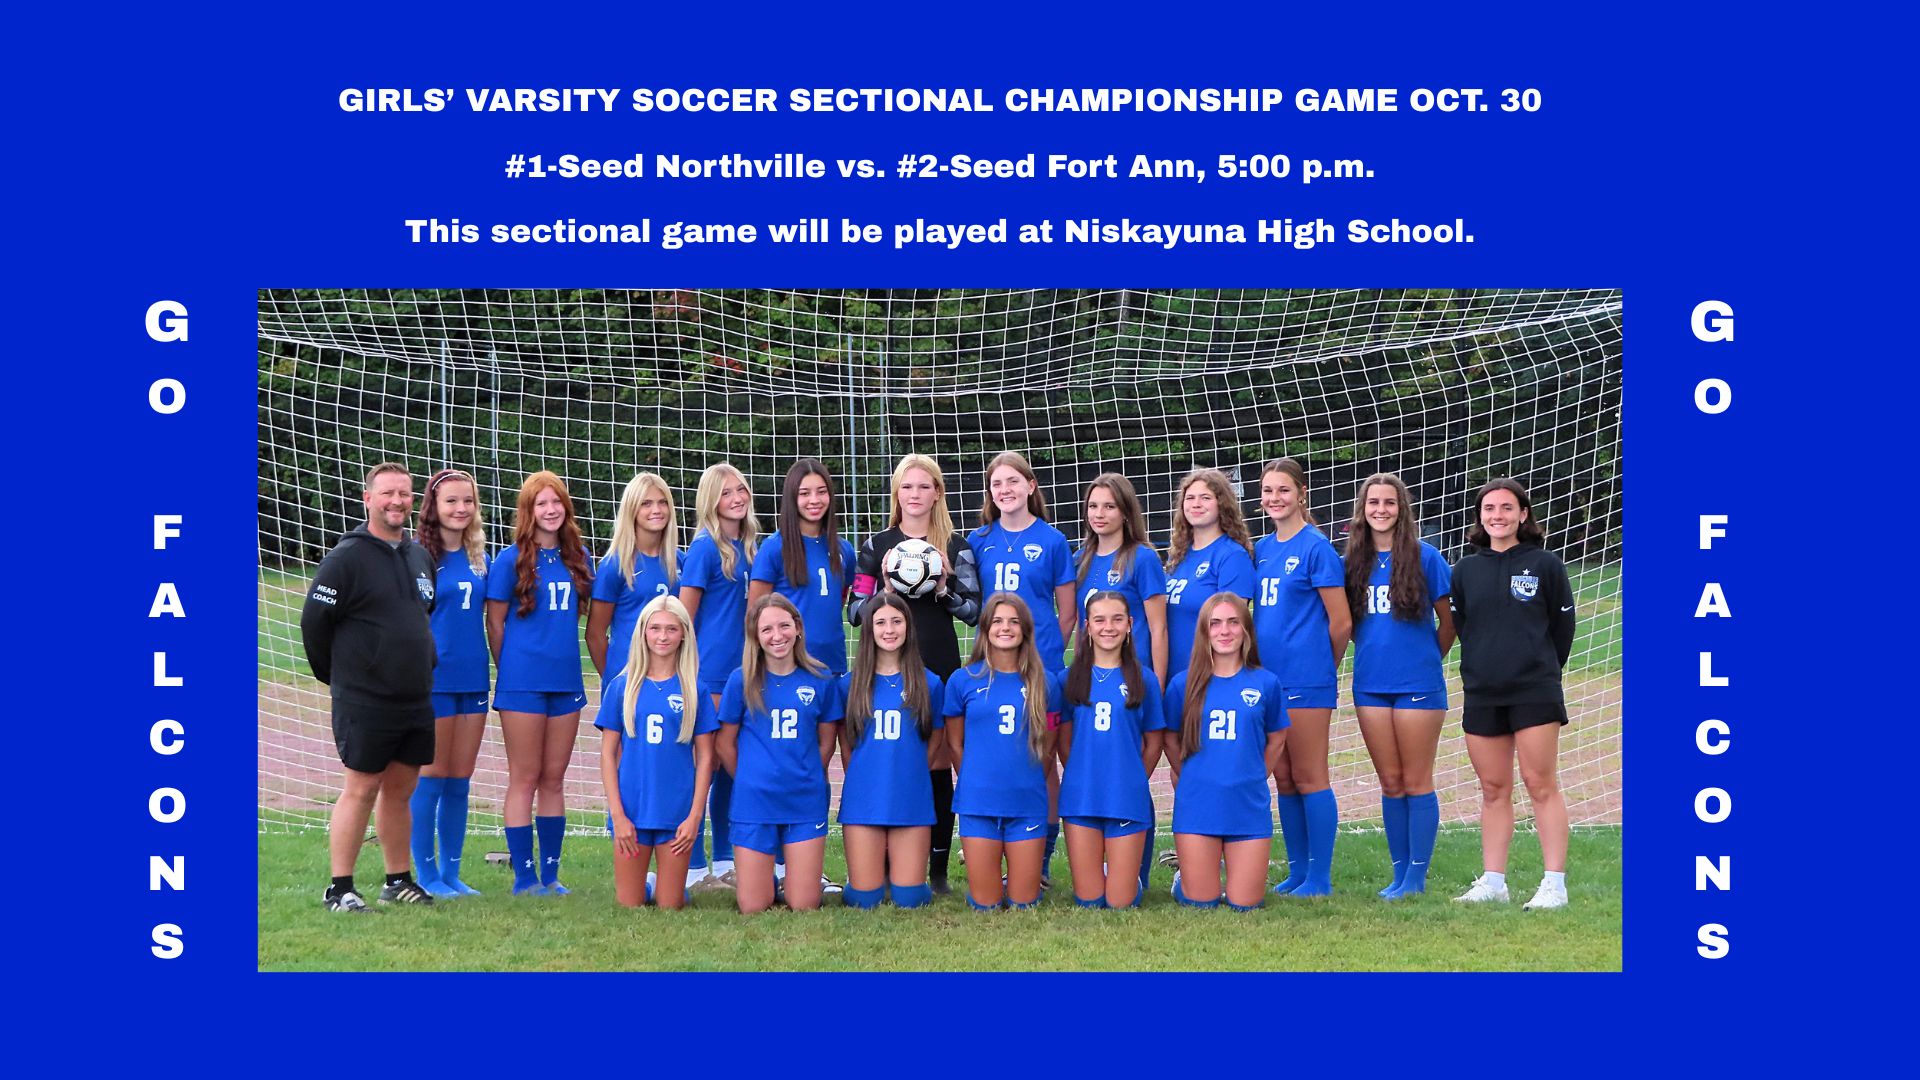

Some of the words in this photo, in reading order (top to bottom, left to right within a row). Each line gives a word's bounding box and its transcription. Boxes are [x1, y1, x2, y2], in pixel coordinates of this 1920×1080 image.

[897, 552, 929, 562] SPALDING
[317, 584, 337, 595] HEAD
[818, 568, 828, 595] 1
[994, 563, 1020, 591] 16
[1511, 580, 1538, 590] FALCONS
[313, 593, 337, 605] COACH
[458, 582, 472, 610] 7
[548, 582, 571, 610] 17
[1166, 579, 1188, 604] 22
[1261, 578, 1281, 606] 15
[1367, 585, 1391, 613] 18
[647, 714, 663, 744] 6
[771, 709, 798, 739] 12
[874, 710, 901, 740] 10
[999, 705, 1015, 734] 3
[1095, 702, 1111, 731] 8
[1209, 710, 1236, 740] 21
